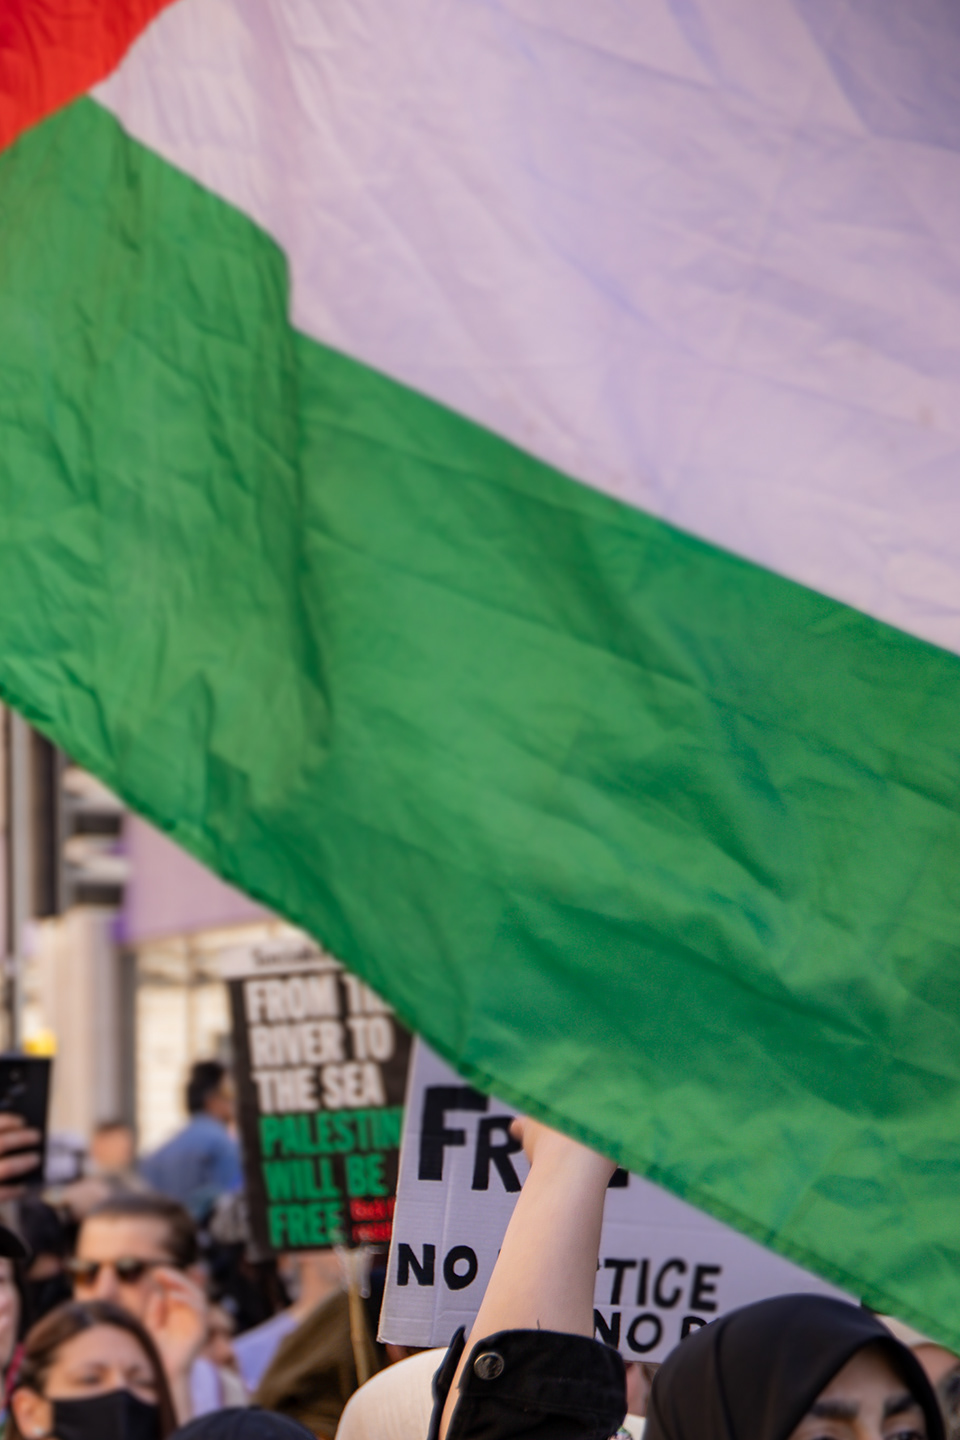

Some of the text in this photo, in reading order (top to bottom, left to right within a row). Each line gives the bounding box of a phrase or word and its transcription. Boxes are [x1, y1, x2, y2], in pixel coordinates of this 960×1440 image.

[244, 972, 339, 1023] FROM
[249, 1016, 395, 1068] RIVER TO
[252, 1062, 386, 1114] THE SEA
[259, 1106, 403, 1156] PALESTIN
[263, 1154, 388, 1201] WILL BE
[269, 1202, 346, 1248] FREE
[397, 1243, 478, 1290] NO
[594, 1309, 662, 1353] NO
